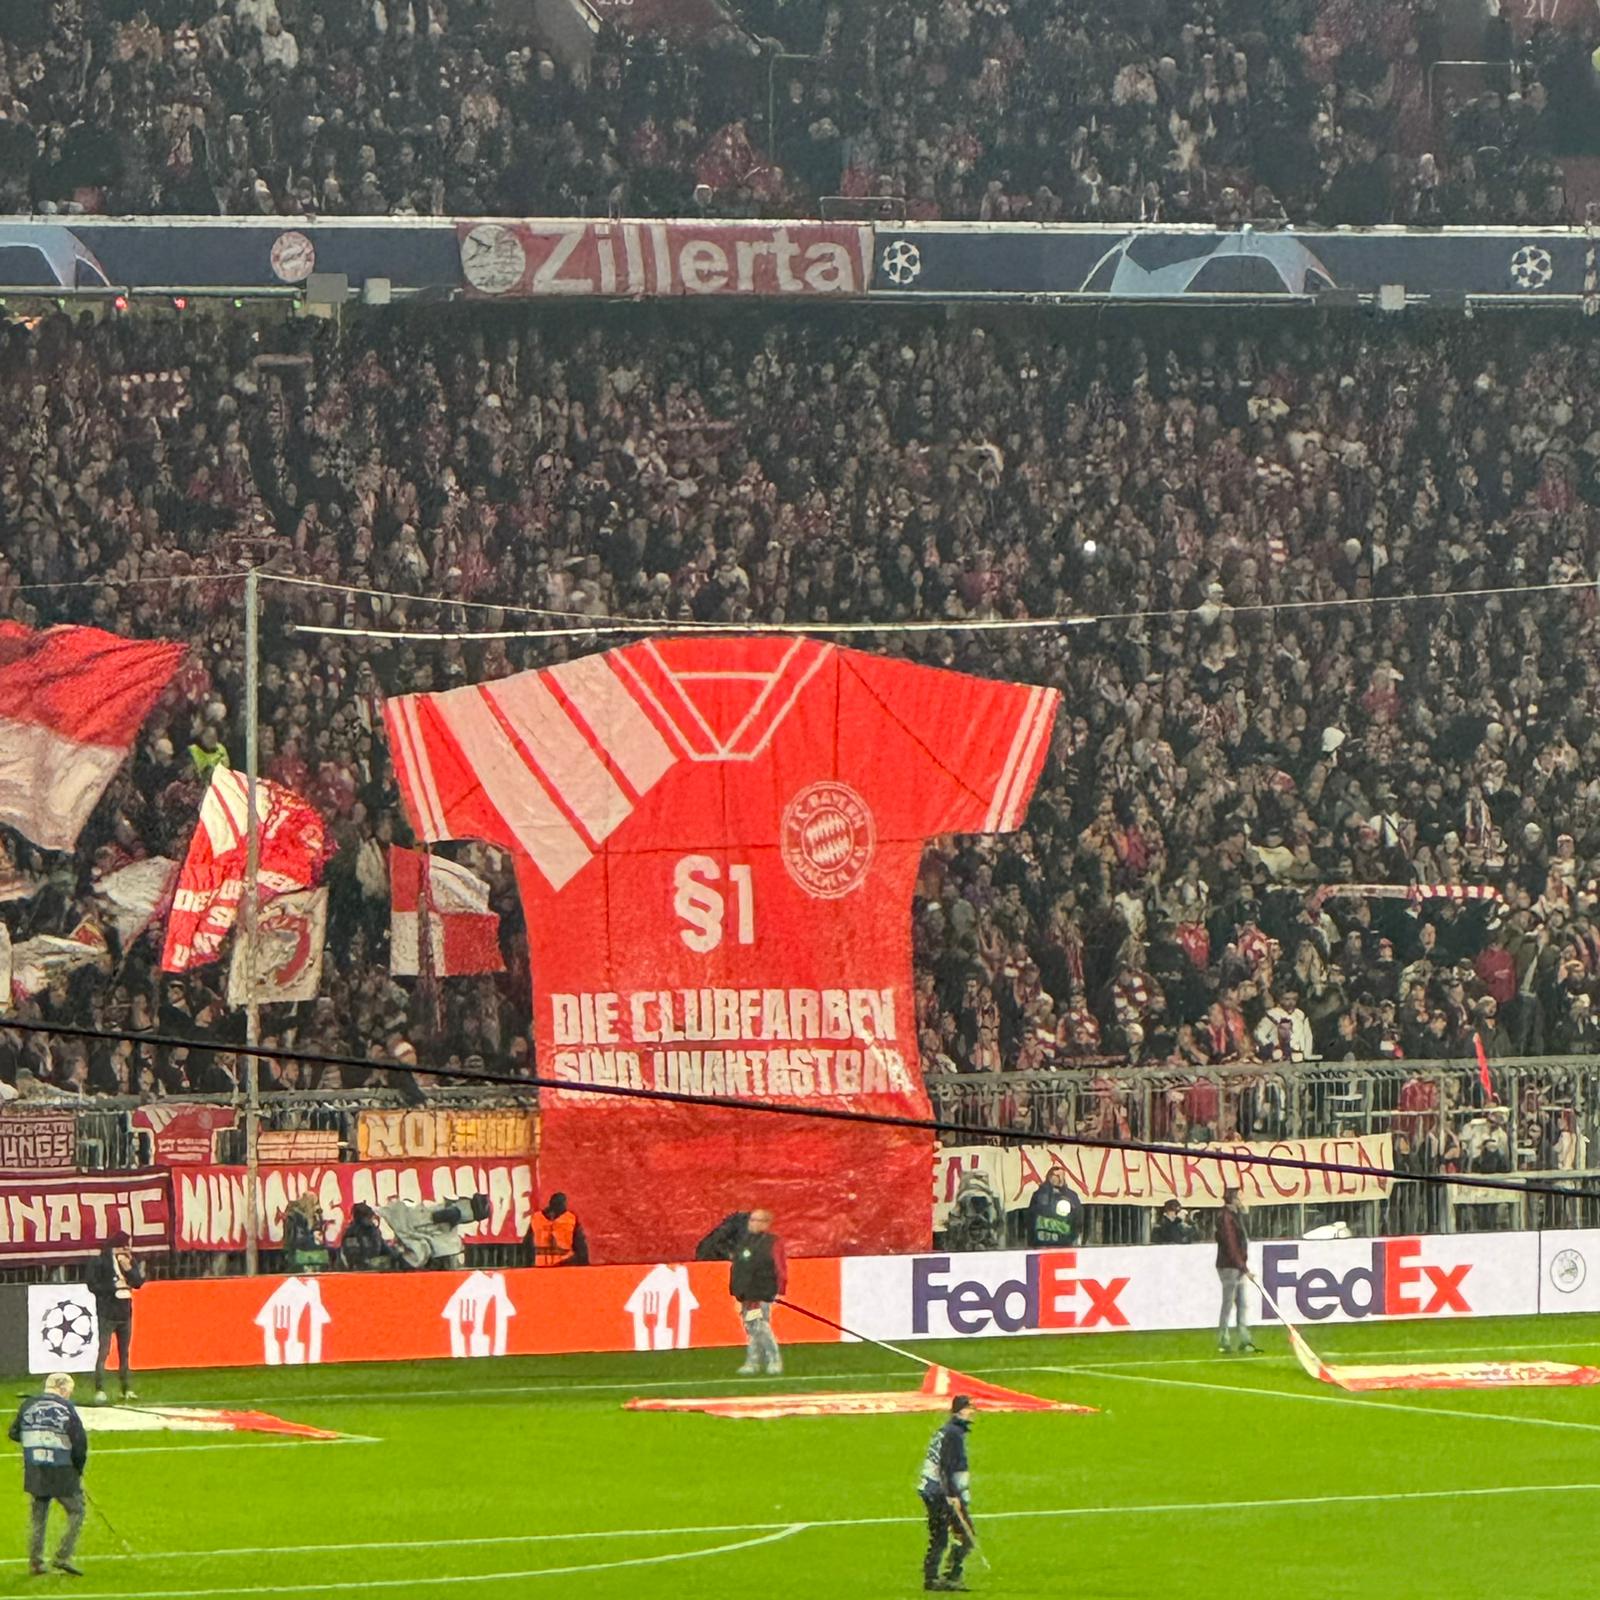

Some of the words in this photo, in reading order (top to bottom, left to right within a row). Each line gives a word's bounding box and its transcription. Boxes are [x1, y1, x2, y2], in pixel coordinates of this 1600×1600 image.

[551, 991, 620, 1045] DIE
[630, 987, 897, 1044] CLUBFARBEN
[553, 1047, 645, 1099] SIND
[653, 1047, 917, 1097] UNANTASTBAR
[912, 1248, 1131, 1335] FedEx
[1262, 1234, 1474, 1320] FedEx
